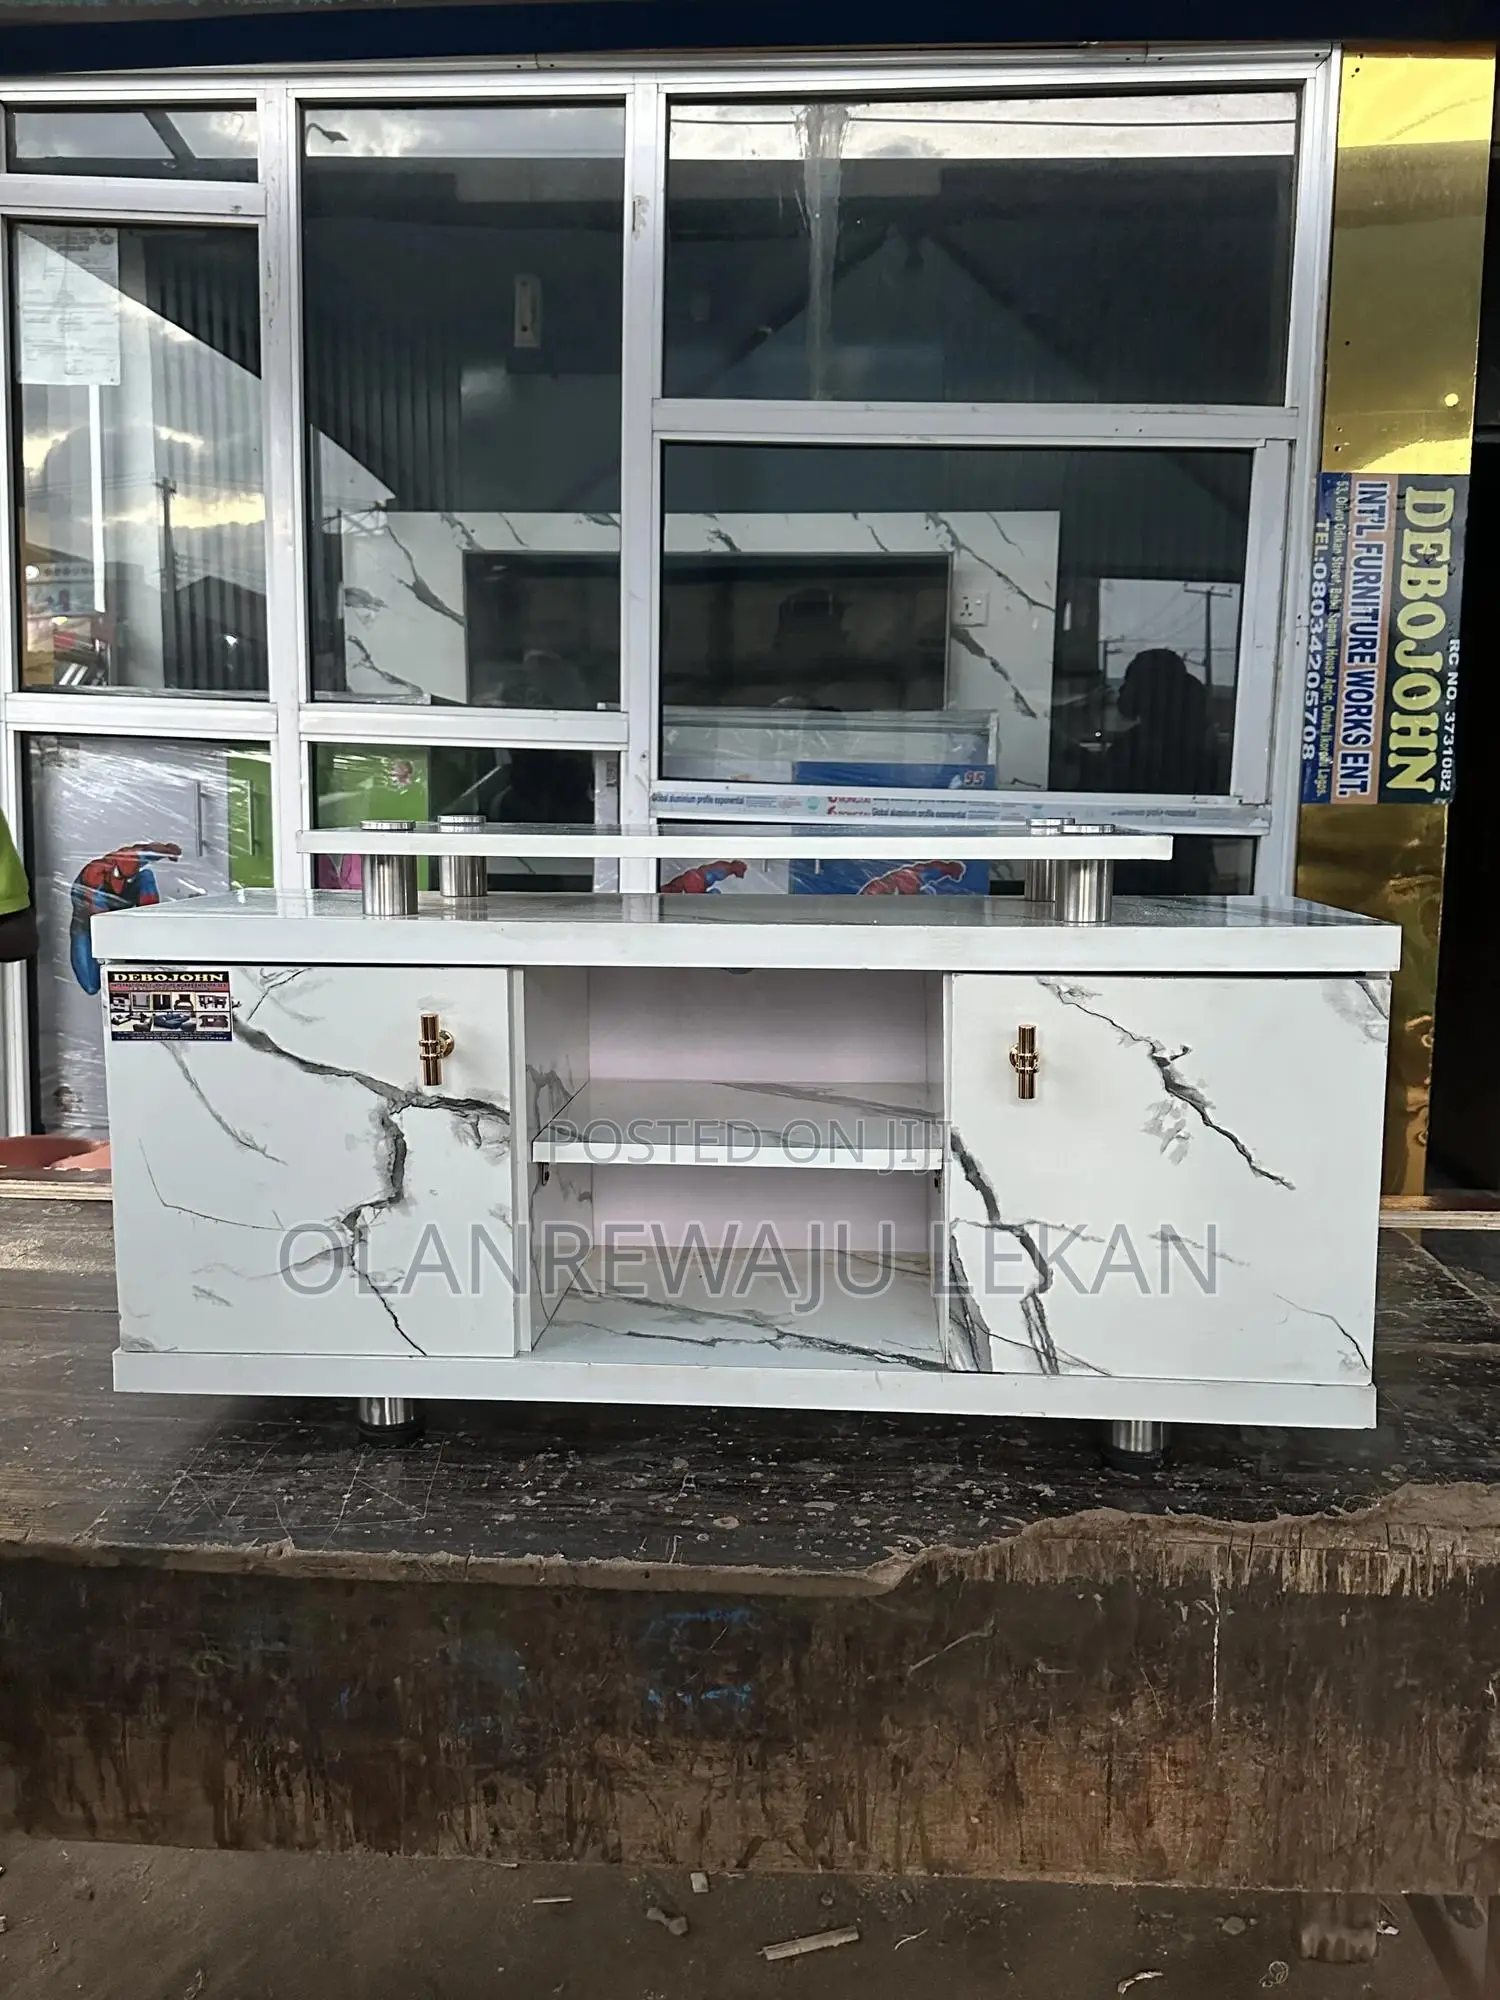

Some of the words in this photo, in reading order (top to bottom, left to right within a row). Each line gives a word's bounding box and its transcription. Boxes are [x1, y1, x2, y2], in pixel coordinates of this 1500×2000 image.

[1354, 481, 1390, 537] INT'L
[1346, 541, 1386, 666] FURNITURE
[1301, 518, 1330, 761] TEL:08034205708
[1324, 648, 1339, 676] House
[1385, 486, 1456, 794] DEBOJOHN
[1449, 638, 1461, 665] RC
[1320, 677, 1337, 703] Agric,
[1341, 669, 1378, 747] WORKS
[1445, 672, 1459, 706] NO.
[1336, 752, 1372, 797] ENT.
[1440, 711, 1456, 793] 3731082
[964, 770, 985, 787] 95
[113, 973, 224, 982] DEBOJOHN
